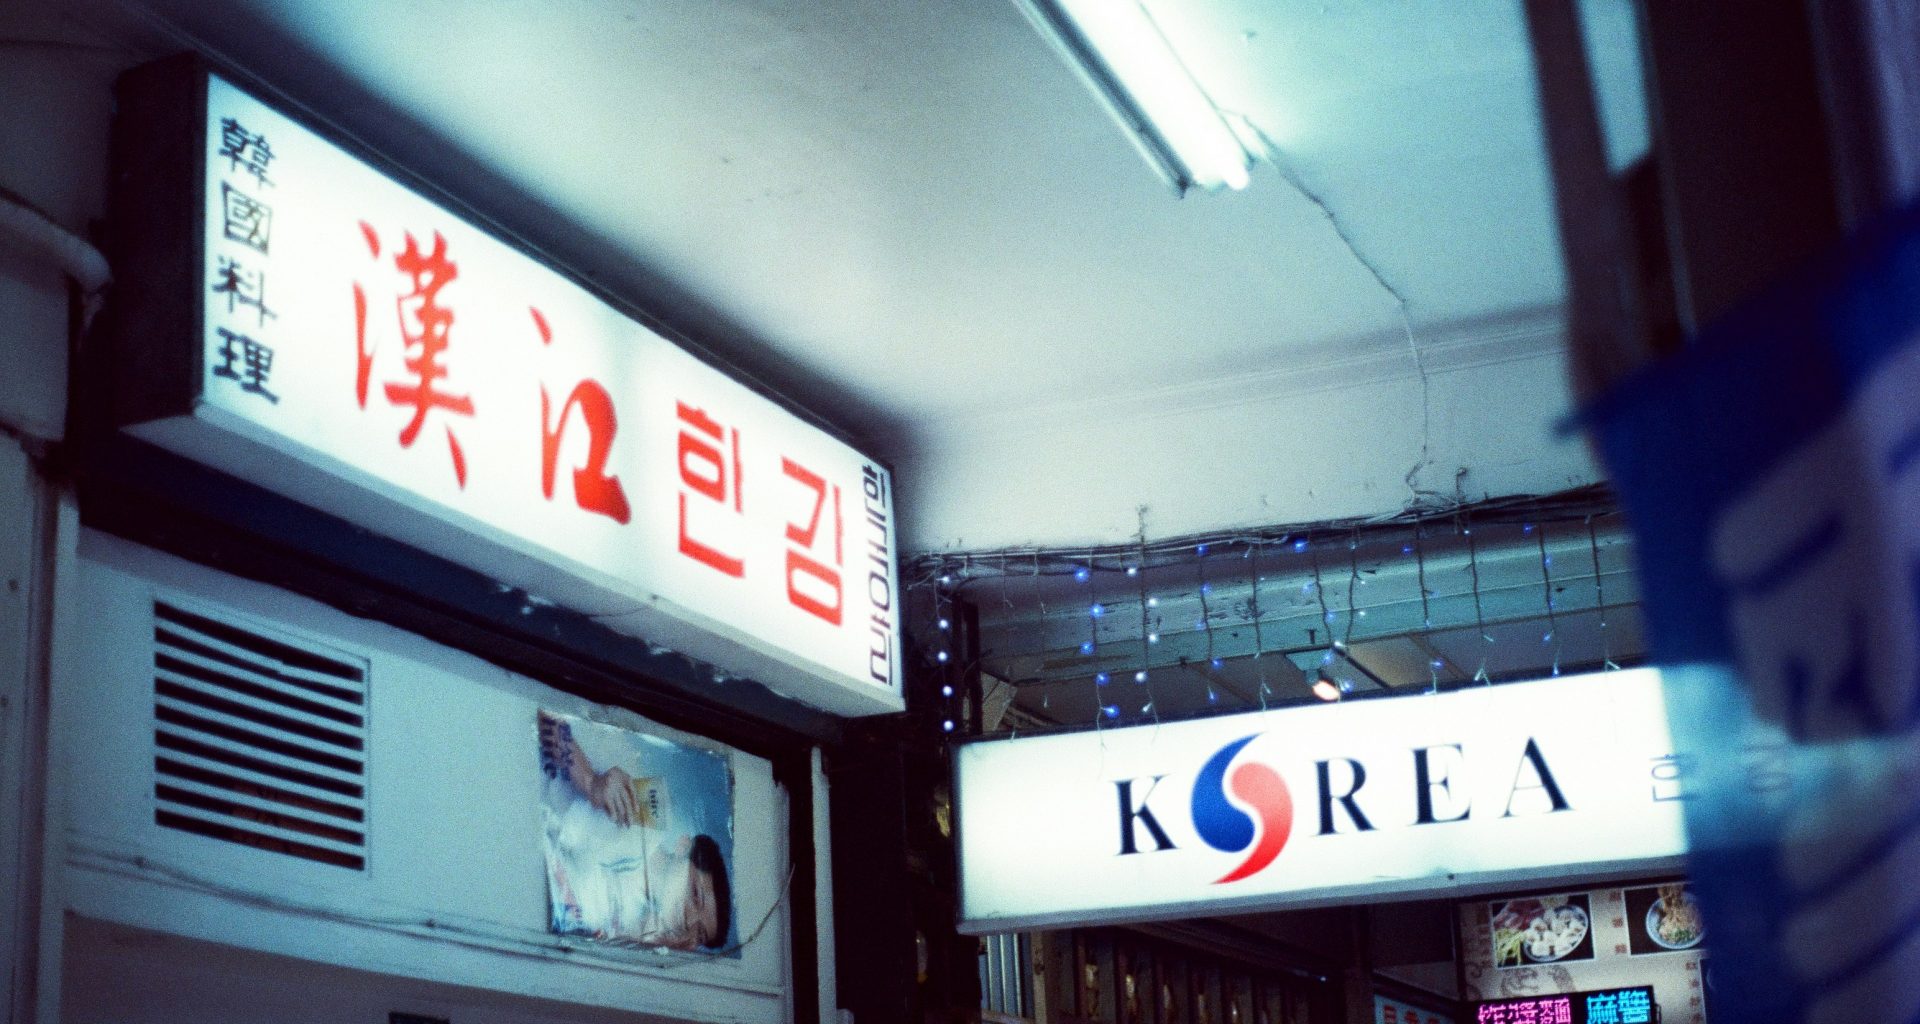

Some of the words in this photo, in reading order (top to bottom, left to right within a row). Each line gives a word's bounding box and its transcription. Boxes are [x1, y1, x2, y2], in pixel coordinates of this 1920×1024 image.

[212, 117, 280, 405] 韓國料理
[352, 219, 632, 525] 漢江
